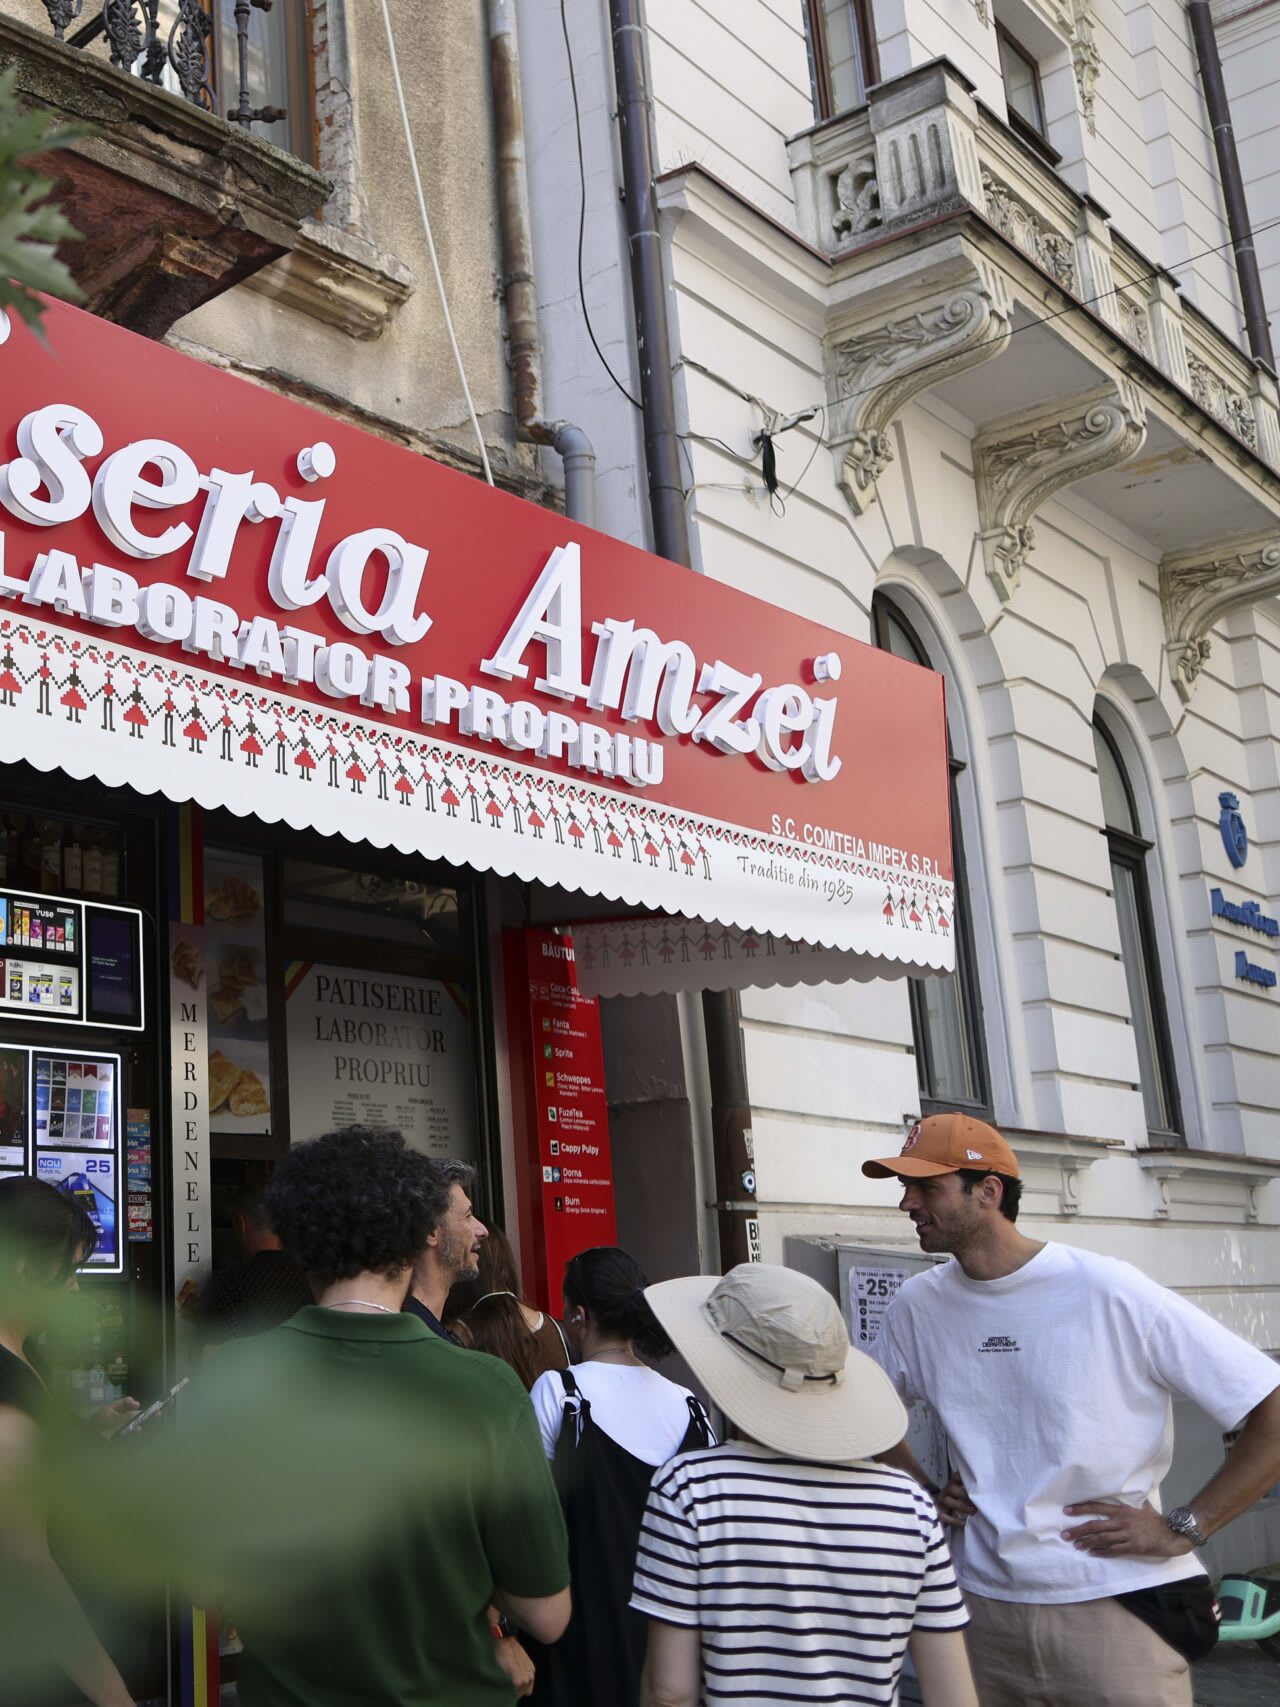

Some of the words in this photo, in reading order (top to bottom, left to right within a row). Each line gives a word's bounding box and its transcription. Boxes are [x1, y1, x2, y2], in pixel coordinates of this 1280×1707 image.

[481, 541, 842, 783] Amzei
[421, 674, 664, 788] PROPRIU
[771, 814, 800, 840] S.C.
[868, 841, 908, 871] IMPEX
[737, 856, 794, 884] Traditie
[798, 868, 819, 891] din
[823, 879, 854, 905] 1985
[315, 974, 443, 1017] PATISERIE
[553, 1019, 570, 1029] Fanta
[315, 1016, 446, 1053] LABORATOR
[555, 1047, 574, 1058] Sprite
[334, 1055, 431, 1087] PROPRIU
[556, 1072, 592, 1085] Schweppes
[559, 1107, 583, 1118] FuzeTea
[180, 1003, 200, 1264] MERDENELE
[561, 1143, 580, 1154] Cappy
[582, 1144, 599, 1156] Pulpy
[39, 1159, 60, 1167] NOU
[86, 1159, 110, 1173] 25
[562, 1167, 582, 1178] Dorna
[565, 1196, 580, 1206] Burn
[866, 1278, 888, 1296] 25
